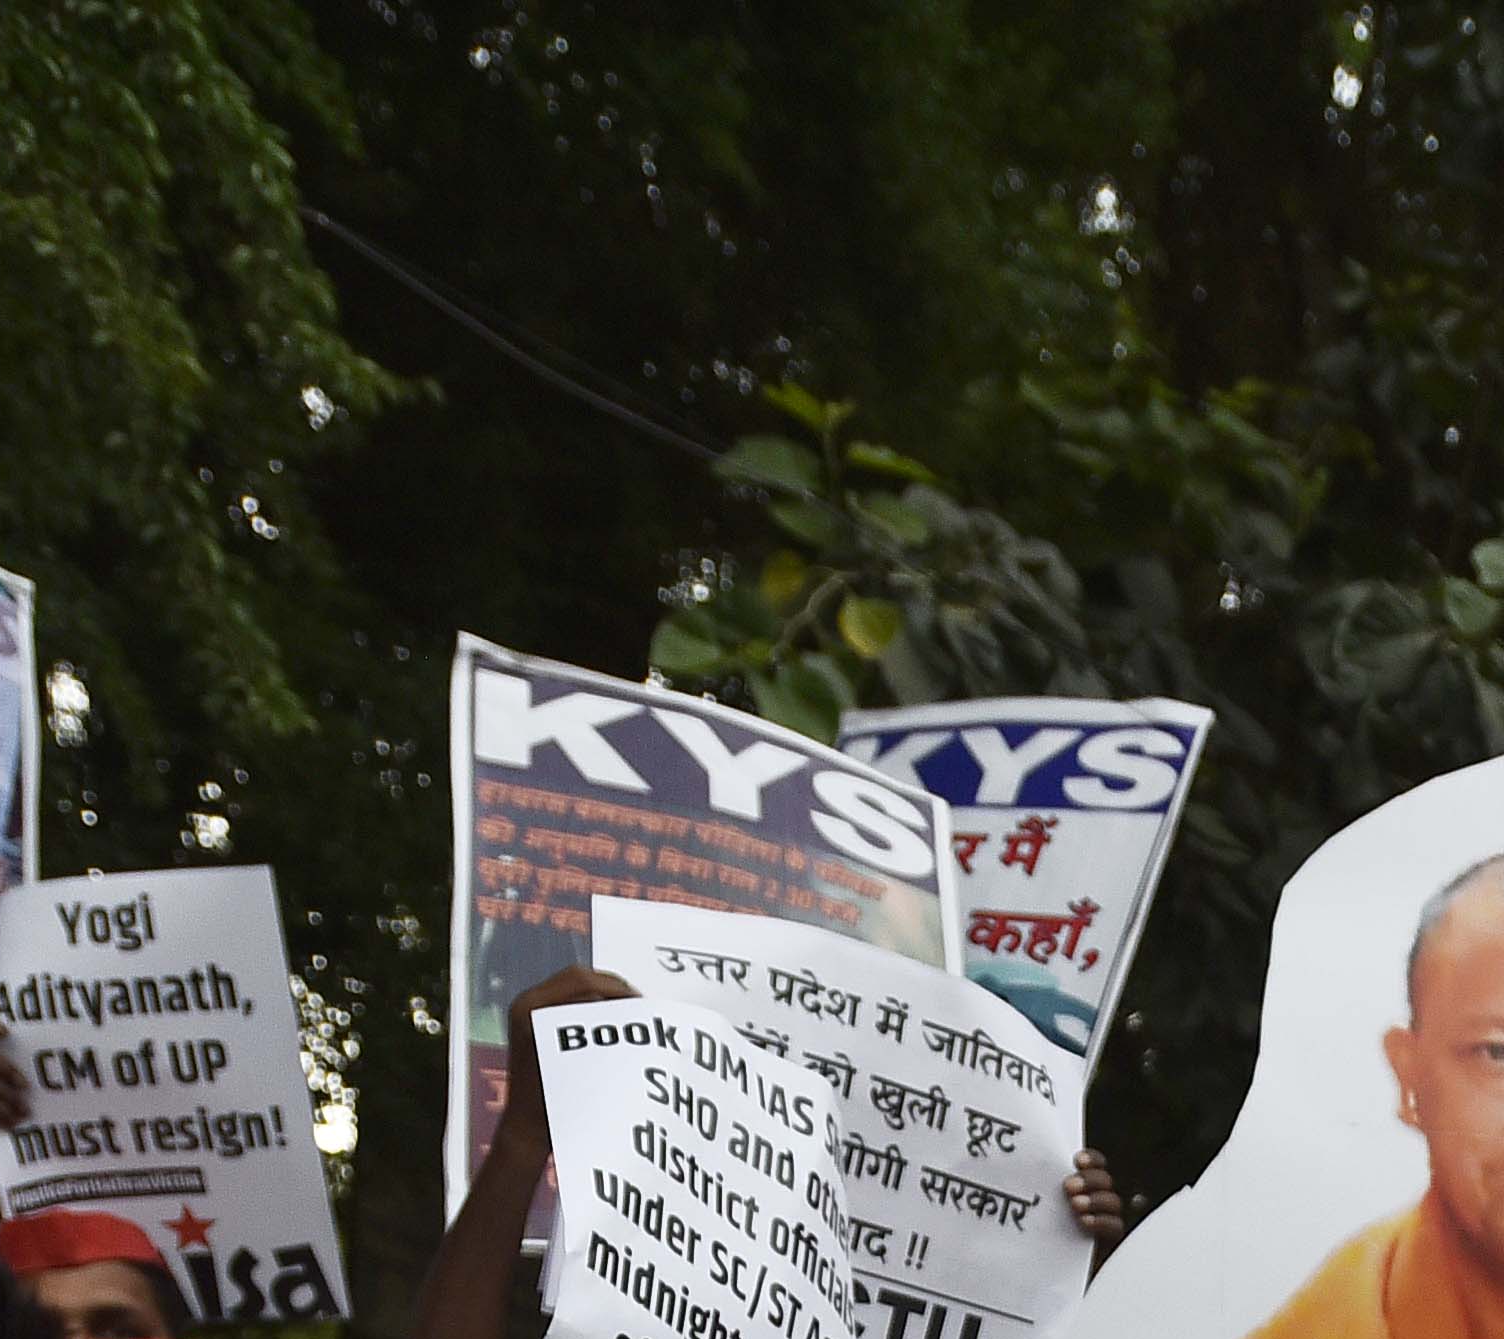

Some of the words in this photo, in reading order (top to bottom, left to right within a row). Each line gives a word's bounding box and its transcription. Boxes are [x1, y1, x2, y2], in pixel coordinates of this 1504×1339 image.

[474, 668, 934, 877] KYS
[842, 728, 1186, 808] KYS
[56, 892, 155, 951] Yogi
[655, 946, 751, 991] उत्तर
[767, 968, 862, 1028] प्रदेश
[876, 996, 909, 1045] में
[33, 1046, 101, 1091] CM
[111, 1036, 157, 1088] of
[168, 1038, 228, 1084] UP
[556, 1016, 682, 1053] Book
[693, 1028, 749, 1097] DM
[10, 1117, 122, 1165] must
[128, 1105, 289, 1158] resign!
[643, 1065, 720, 1142] SHO
[727, 1120, 795, 1192] and
[870, 1075, 951, 1131] खुली
[963, 1105, 1022, 1158] छूट
[593, 1167, 702, 1266] under
[632, 1119, 759, 1242] district
